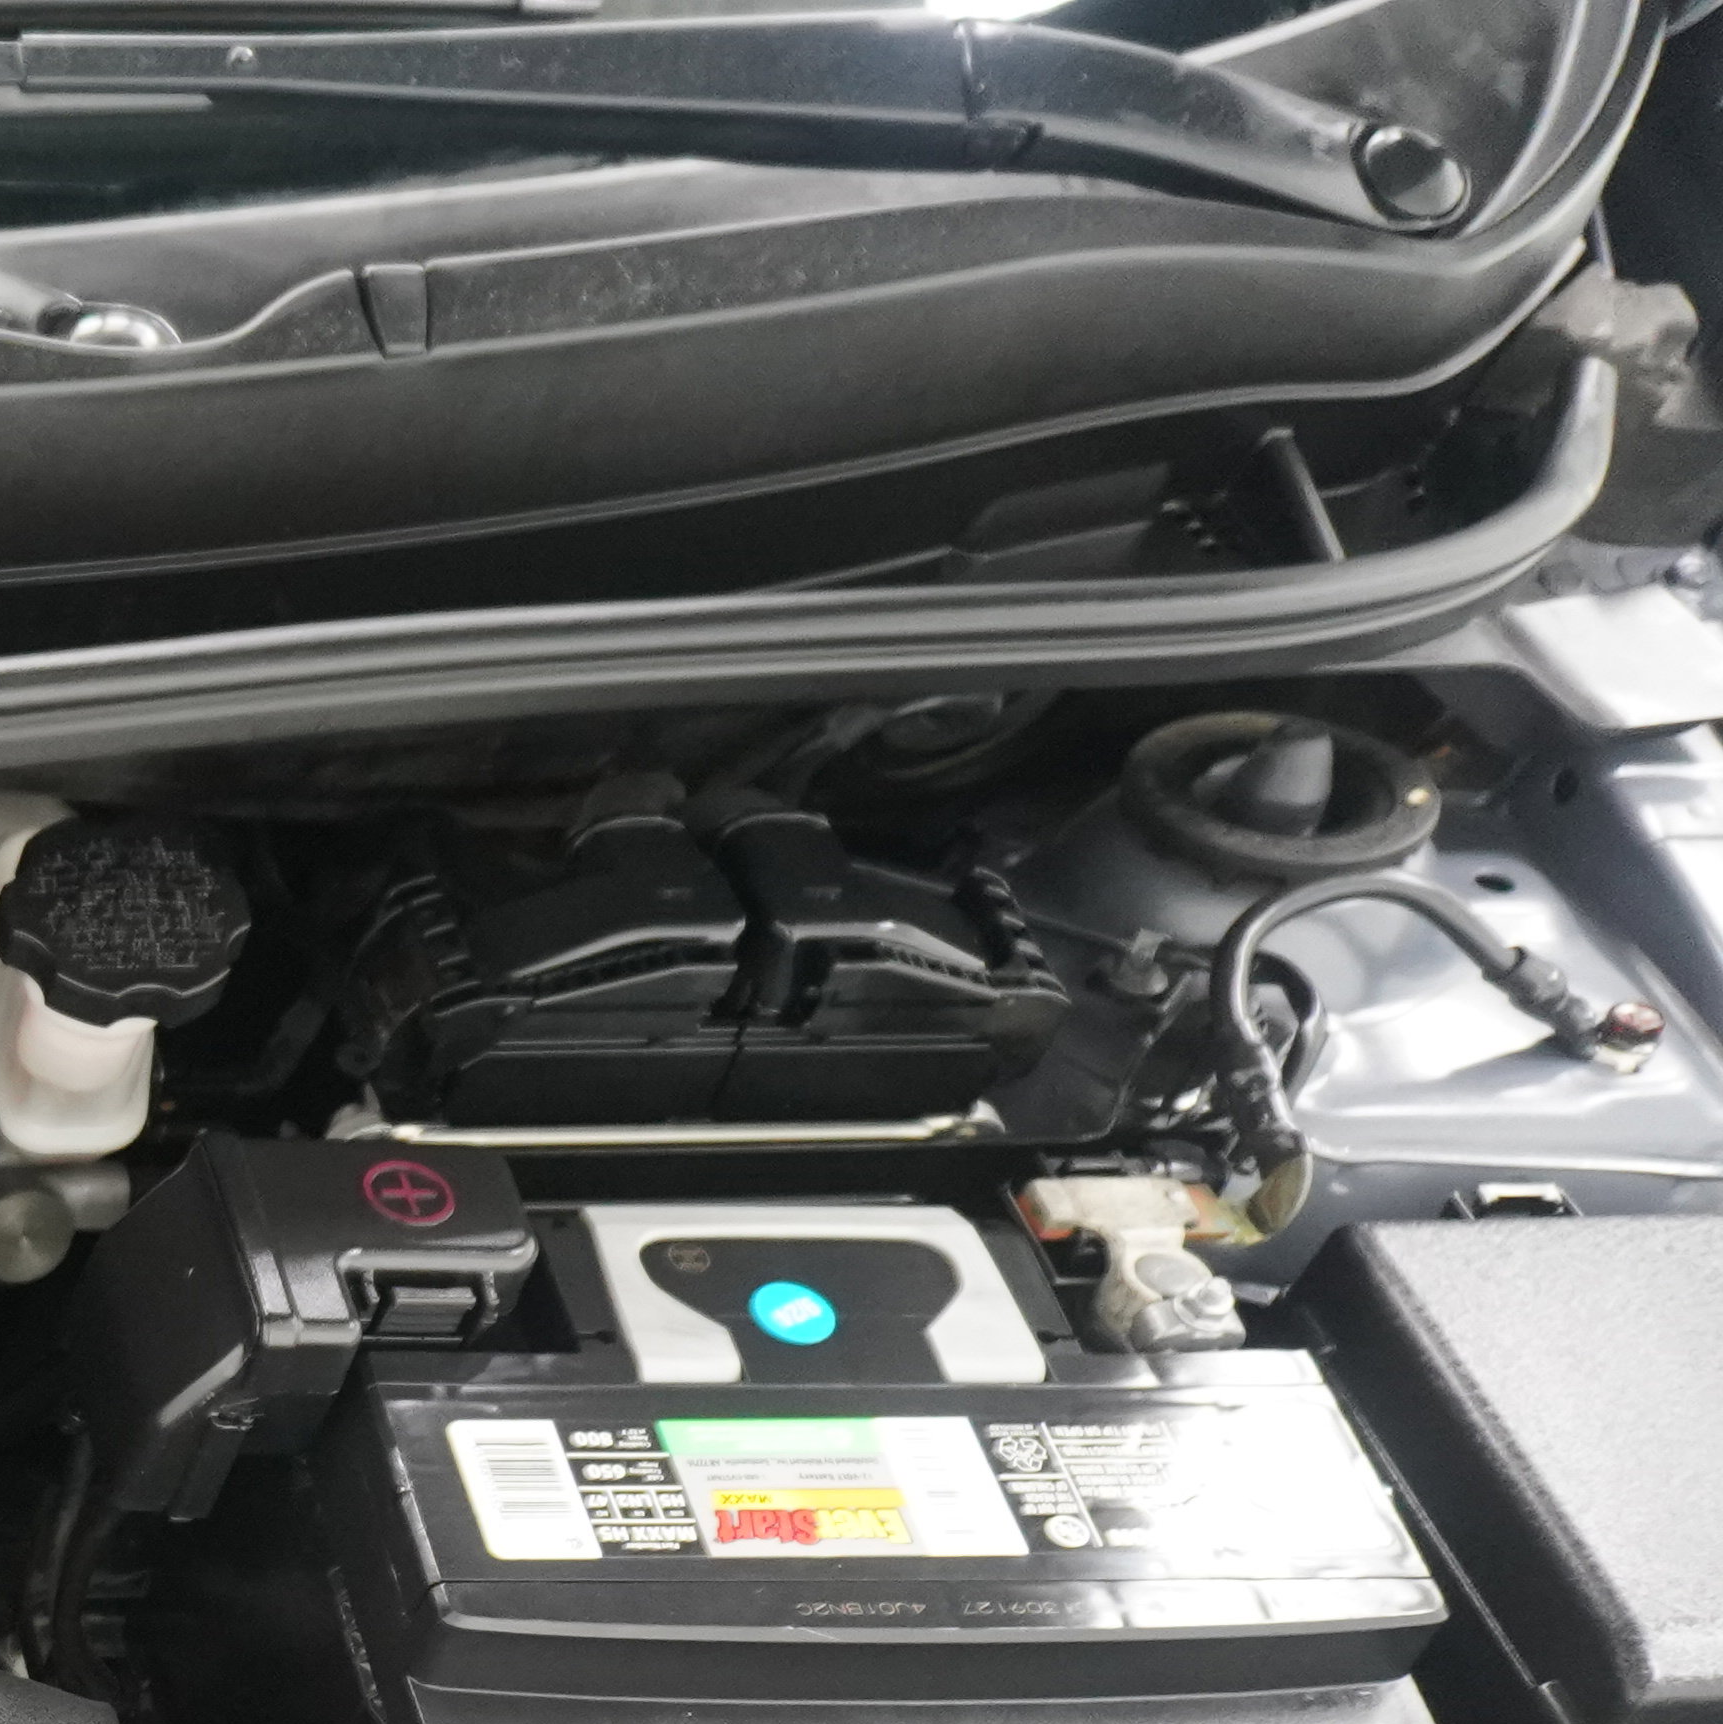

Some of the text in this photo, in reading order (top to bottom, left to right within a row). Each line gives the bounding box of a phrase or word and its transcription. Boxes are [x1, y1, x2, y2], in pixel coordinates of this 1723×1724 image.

[570, 1432, 614, 1449] 800
[584, 1464, 626, 1480] 650
[585, 1494, 608, 1508] 47
[616, 1493, 653, 1508] LN2
[719, 1494, 773, 1504] MAXX
[596, 1525, 630, 1542] H5
[632, 1525, 697, 1542] MAXX
[714, 1508, 914, 1546] EverStart
